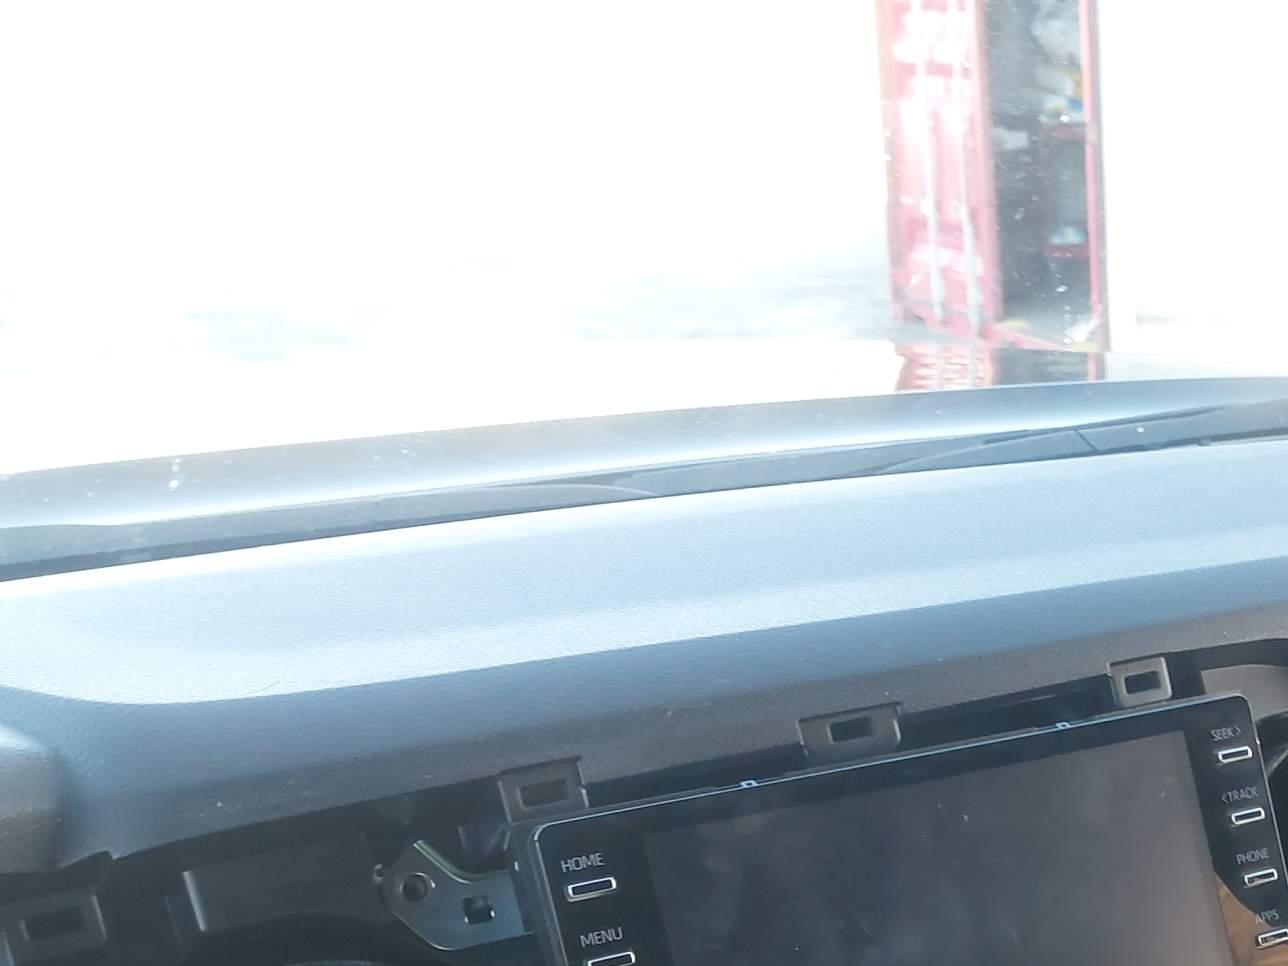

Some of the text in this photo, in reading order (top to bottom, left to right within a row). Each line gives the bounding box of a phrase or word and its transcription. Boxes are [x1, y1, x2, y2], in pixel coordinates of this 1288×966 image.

[1211, 728, 1234, 741] SEEK
[1228, 787, 1258, 802] TRACK
[561, 853, 606, 873] HOME
[1236, 847, 1269, 865] PHONE
[1255, 909, 1280, 926] APPS
[580, 927, 623, 948] MENU
